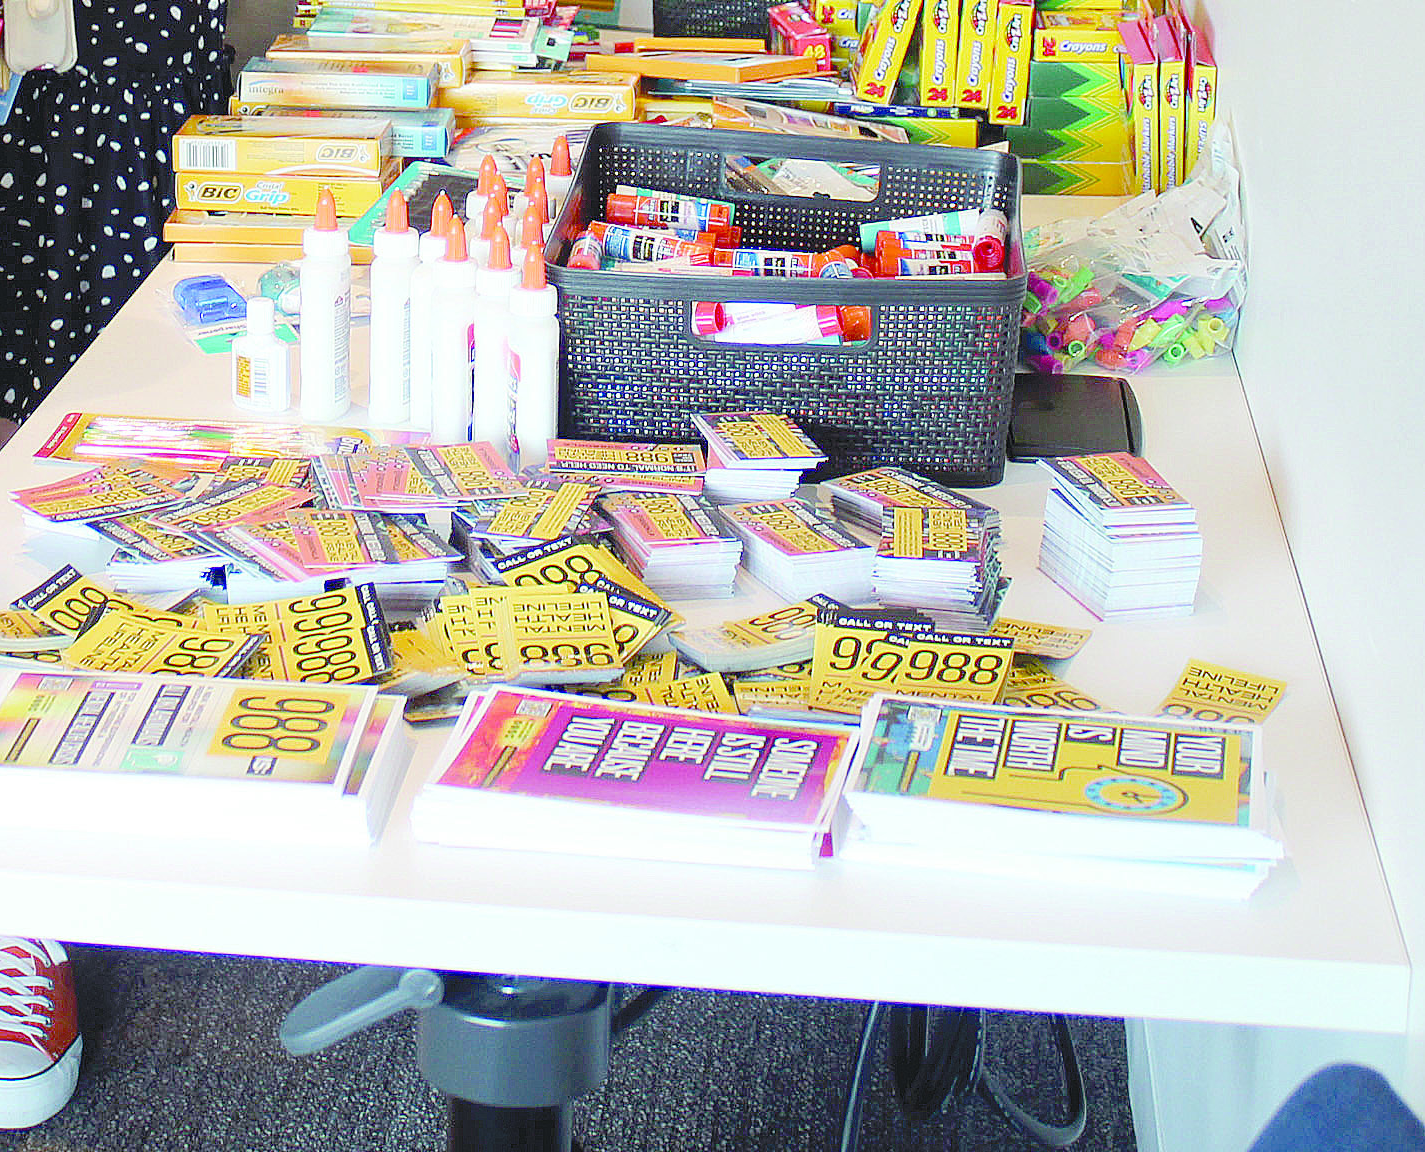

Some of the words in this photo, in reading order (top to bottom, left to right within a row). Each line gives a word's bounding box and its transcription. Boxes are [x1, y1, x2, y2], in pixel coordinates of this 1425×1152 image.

[1060, 40, 1108, 53] Crayons
[874, 36, 897, 81] Crayons
[932, 38, 946, 85] Crayons
[967, 40, 983, 87] Crayons
[1002, 56, 1017, 103] Crayons
[248, 85, 284, 96] integra
[865, 82, 886, 98] 24
[927, 87, 948, 102] 24
[962, 89, 982, 103] 24
[527, 94, 568, 107] Grip
[575, 97, 612, 108] BIC
[996, 106, 1018, 120] 24
[322, 147, 359, 159] BIC
[200, 187, 239, 199] BIC
[246, 189, 289, 205] Grip
[625, 451, 668, 464] 988
[860, 479, 915, 495] 988
[1103, 478, 1152, 495] 988
[756, 513, 804, 531] 988
[497, 555, 526, 570] CALL
[527, 548, 544, 559] OR
[543, 536, 573, 552] TEXT
[513, 601, 603, 613] LIFELINE
[609, 595, 625, 606] OR
[627, 601, 658, 619] TEXT
[515, 613, 605, 623] HEALTH
[839, 617, 872, 628] CALL
[874, 620, 893, 630] OR
[896, 622, 932, 632] TEXT
[521, 624, 606, 633] MENTAL
[916, 632, 950, 643] CALL
[952, 635, 972, 644] OR
[974, 637, 1012, 647] TEXT
[520, 643, 614, 667] 988
[904, 650, 1003, 685] 988
[1188, 666, 1280, 695] LIFELINE
[1183, 677, 1274, 704] HEALTH
[1183, 688, 1268, 711] MENTAL
[222, 696, 334, 753] 988
[558, 714, 615, 745] YOU
[955, 715, 1004, 744] THE
[1067, 724, 1113, 741] IS
[657, 725, 717, 764] HERE
[718, 731, 767, 749] IS
[1005, 720, 1057, 770] WORTH
[1118, 729, 1167, 768] MIND
[593, 720, 665, 780] BECAUSE
[1175, 734, 1222, 774] YOUR
[702, 745, 761, 784] STILL
[749, 736, 819, 801] SOMEONE
